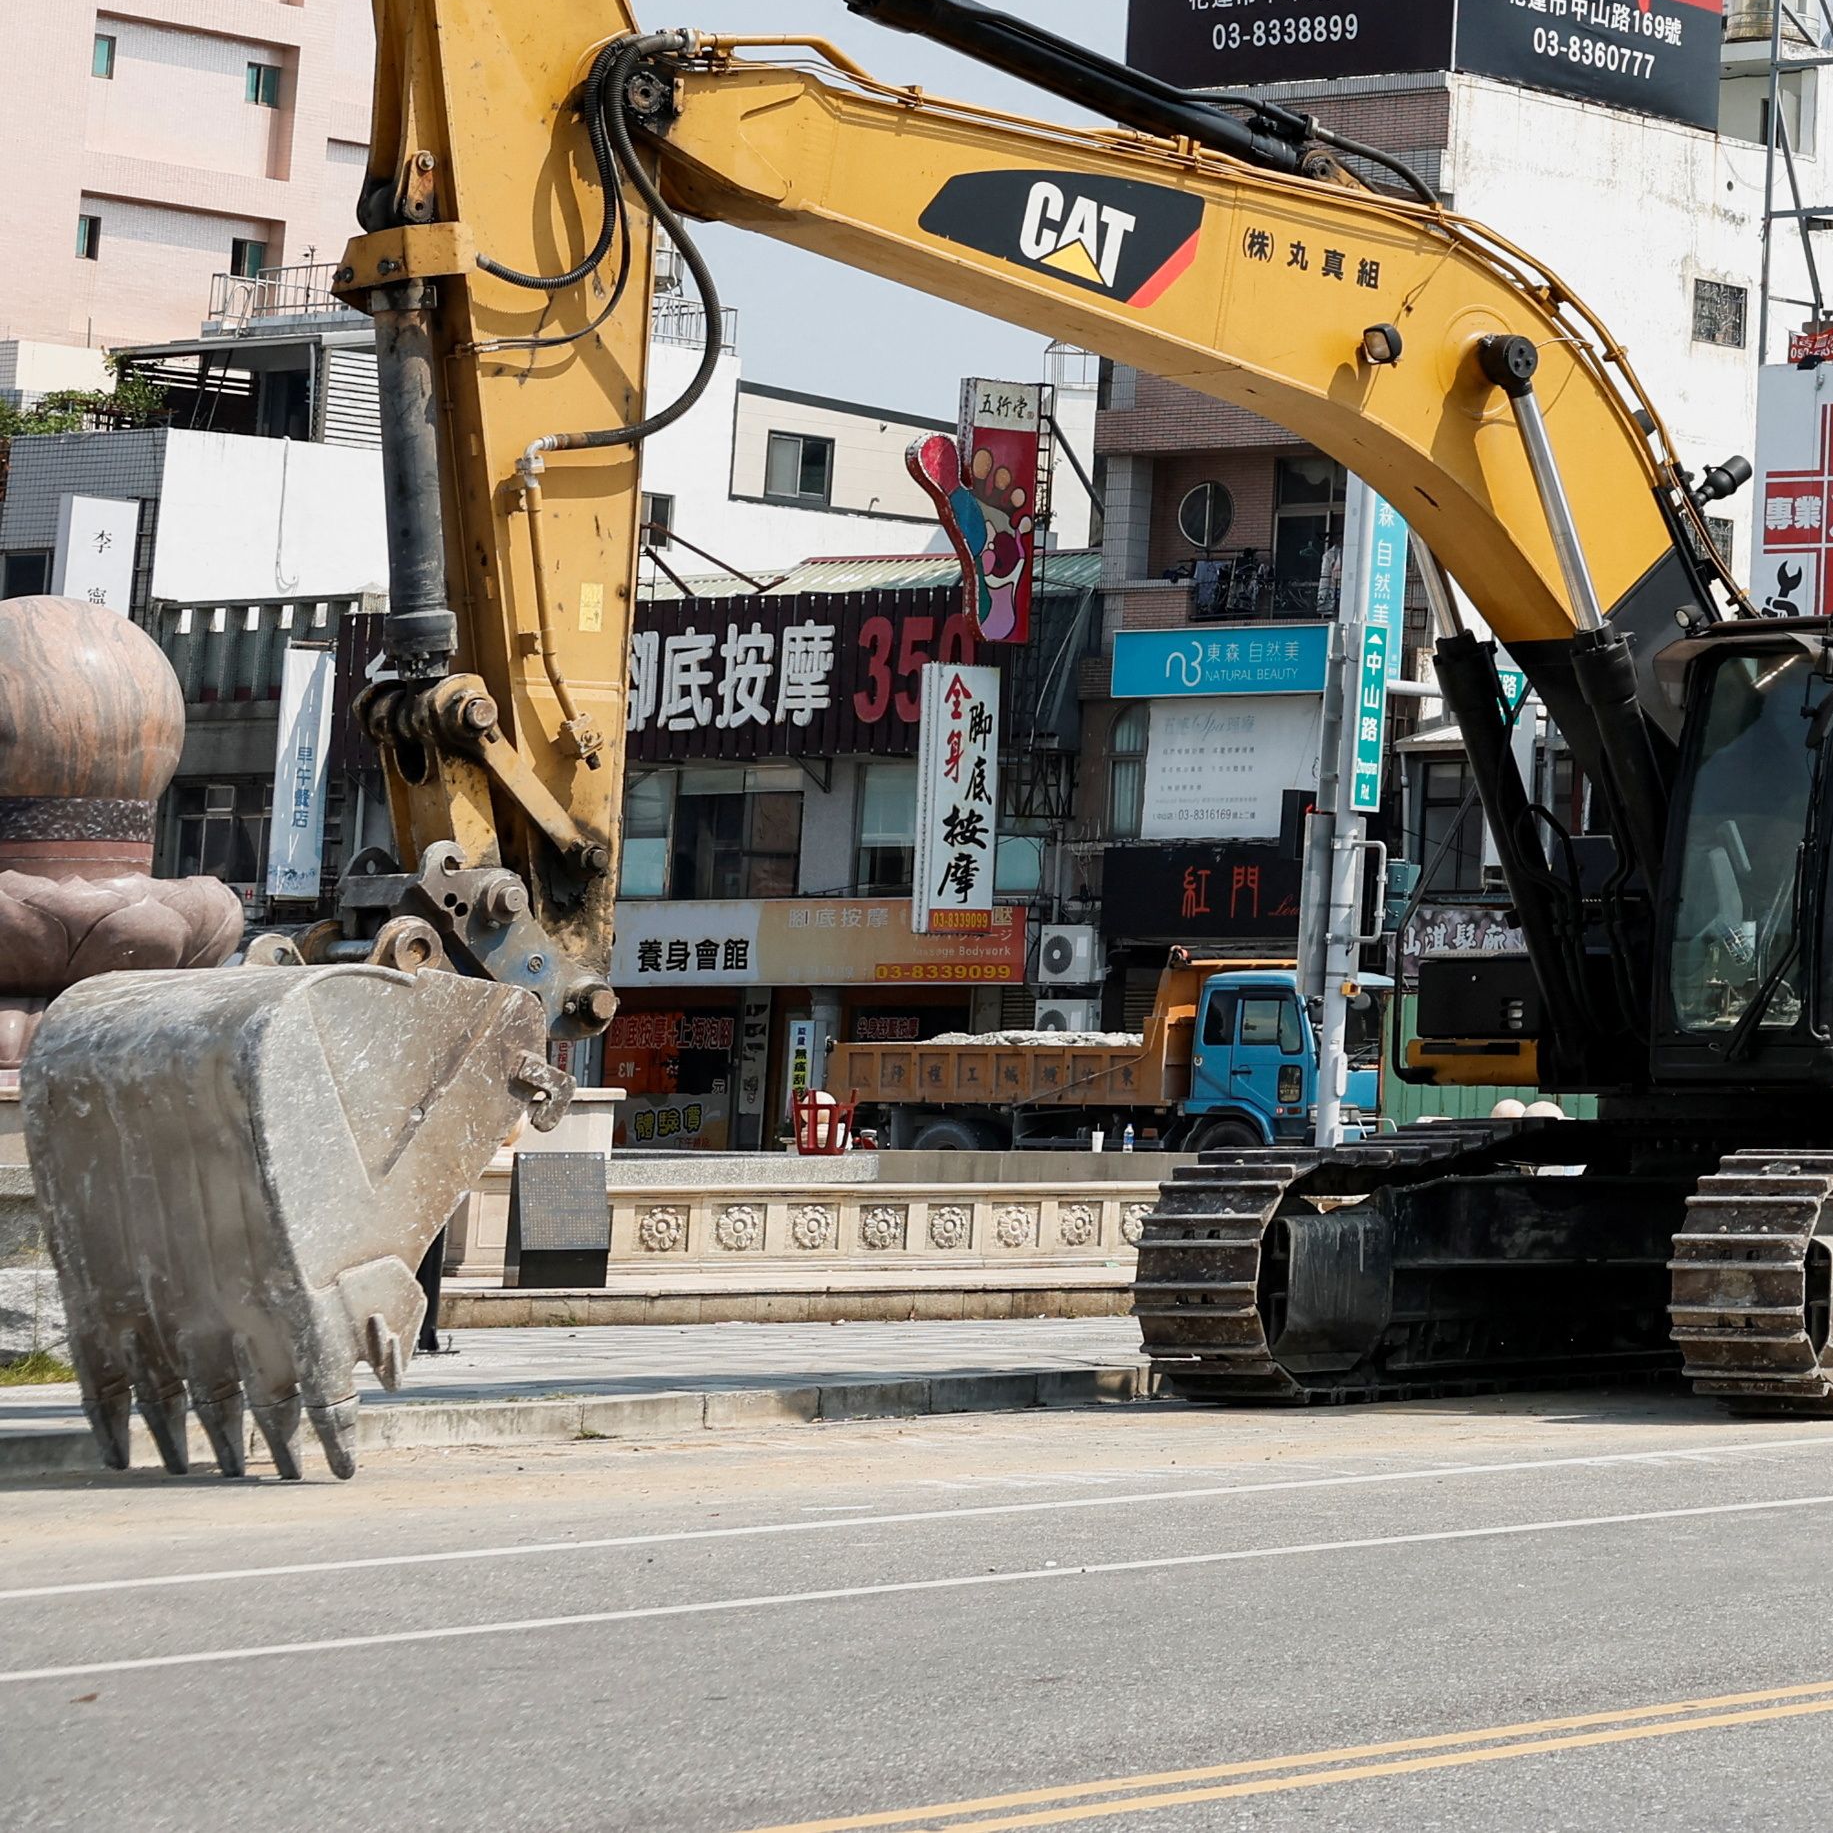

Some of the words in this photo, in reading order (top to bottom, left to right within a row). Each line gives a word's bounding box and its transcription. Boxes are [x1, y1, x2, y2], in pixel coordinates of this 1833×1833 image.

[1212, 16, 1359, 50] 03-8338899
[1532, 27, 1655, 80] 03-8360777
[1020, 180, 1137, 289] CAT
[978, 393, 1028, 419] 五行堂
[1766, 495, 1822, 531] 專業
[1208, 642, 1241, 664] 東森
[1249, 640, 1300, 662] 自然美
[1205, 669, 1252, 682] NATURAL
[1256, 667, 1299, 681] BEAUTY
[1360, 650, 1382, 744] 中山路
[943, 672, 973, 784] 全身
[290, 745, 314, 829] 早午餐店
[1178, 808, 1232, 821] 03-8316169
[1181, 865, 1261, 919] 紅門
[788, 907, 889, 929] 腳底按摩
[932, 911, 990, 929] 03-8339099
[637, 938, 749, 974] 養身會館
[959, 945, 1012, 957] Bodywork
[876, 964, 1012, 980] 03-8339099
